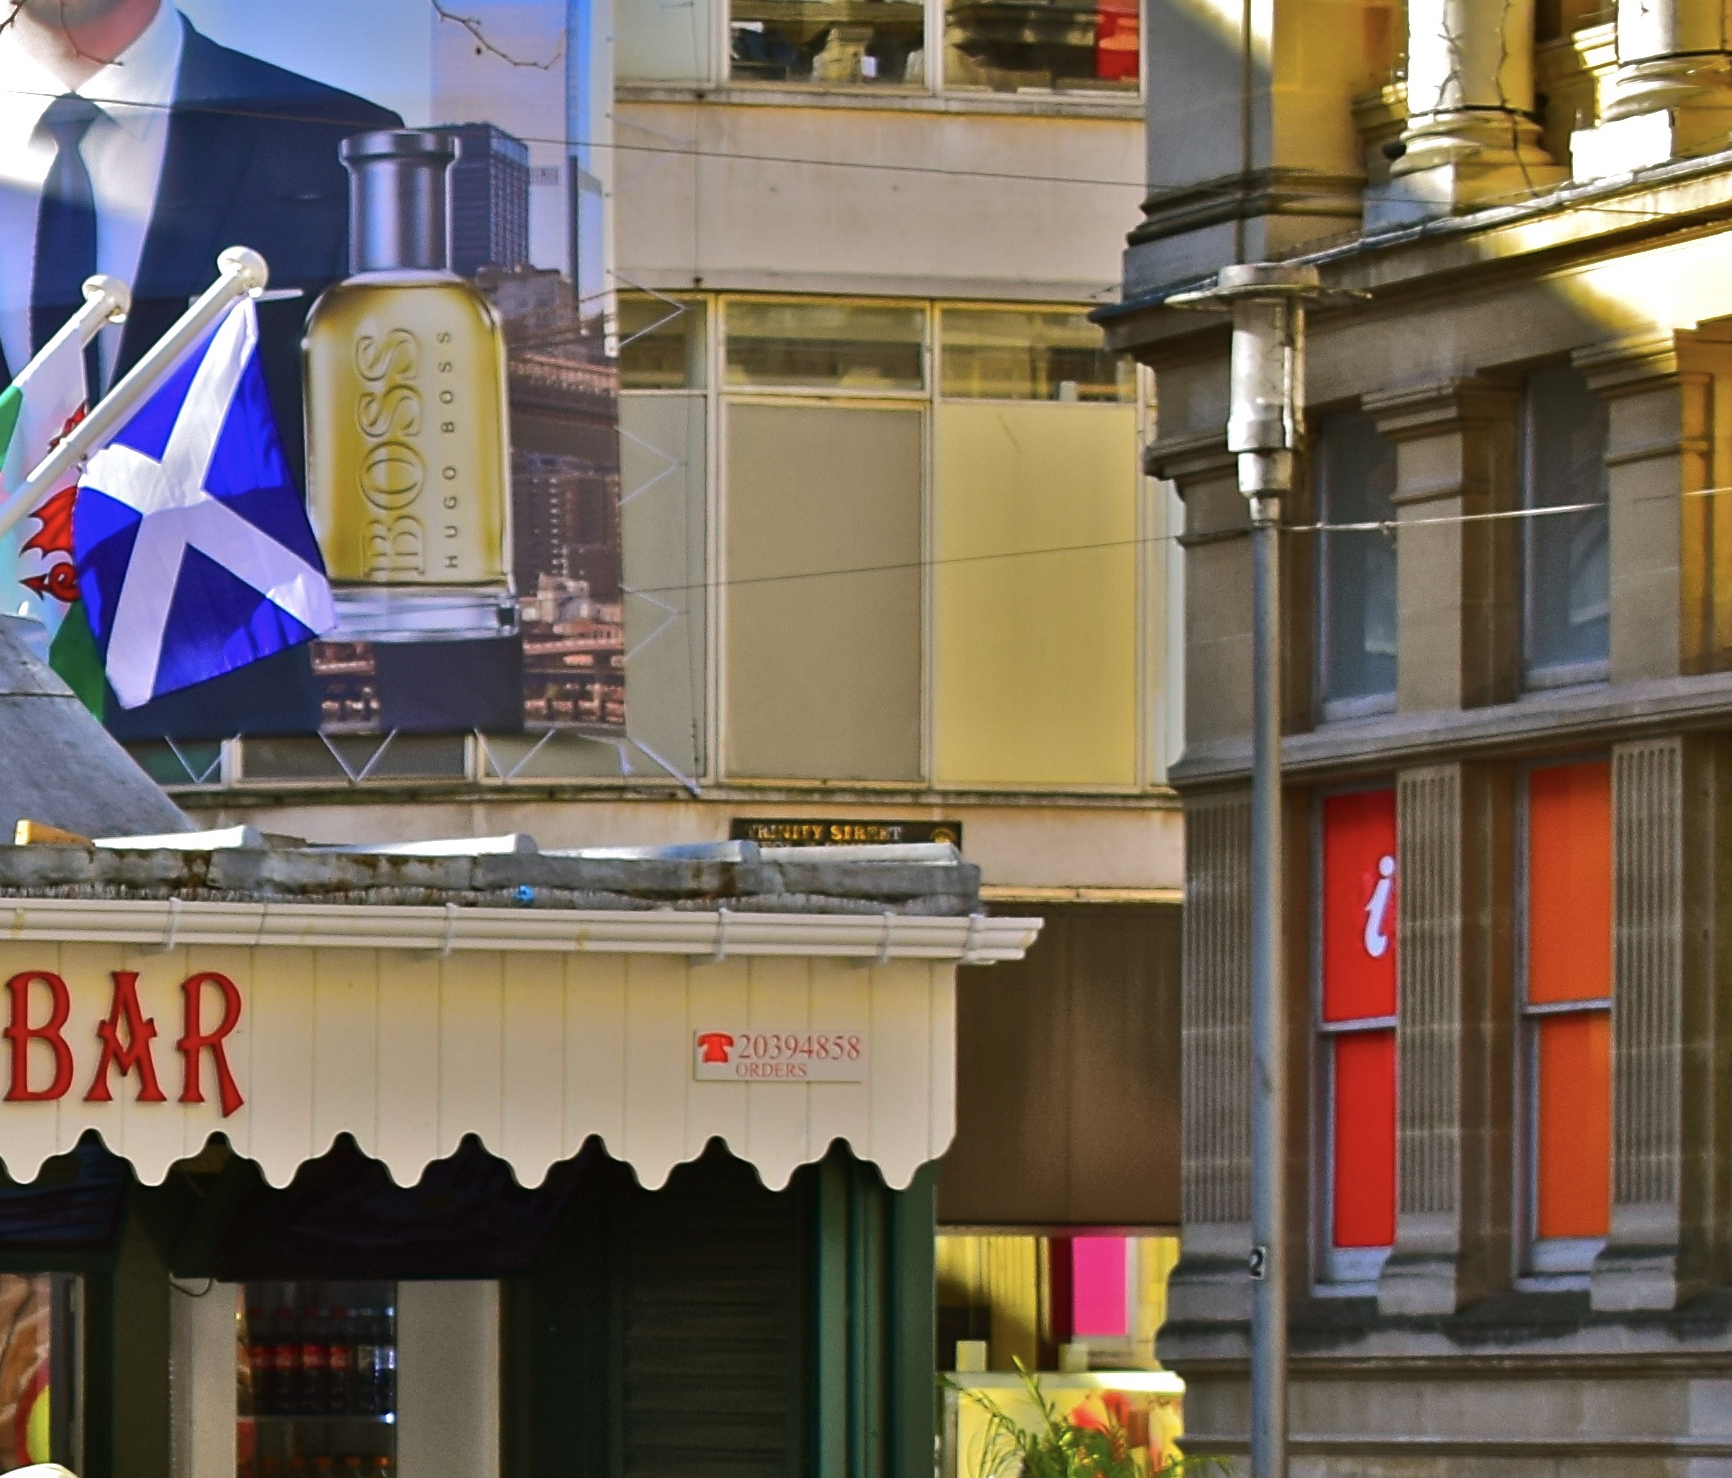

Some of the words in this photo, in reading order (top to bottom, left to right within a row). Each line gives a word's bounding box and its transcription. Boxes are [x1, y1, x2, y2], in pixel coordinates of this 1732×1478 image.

[436, 330, 456, 434] BOSS
[354, 327, 425, 578] BOSS
[442, 465, 459, 571] HUGO
[3, 971, 245, 1119] BAR
[735, 1062, 808, 1078] ORDERS
[738, 1034, 862, 1060] 20394858
[1248, 1249, 1263, 1277] 2
